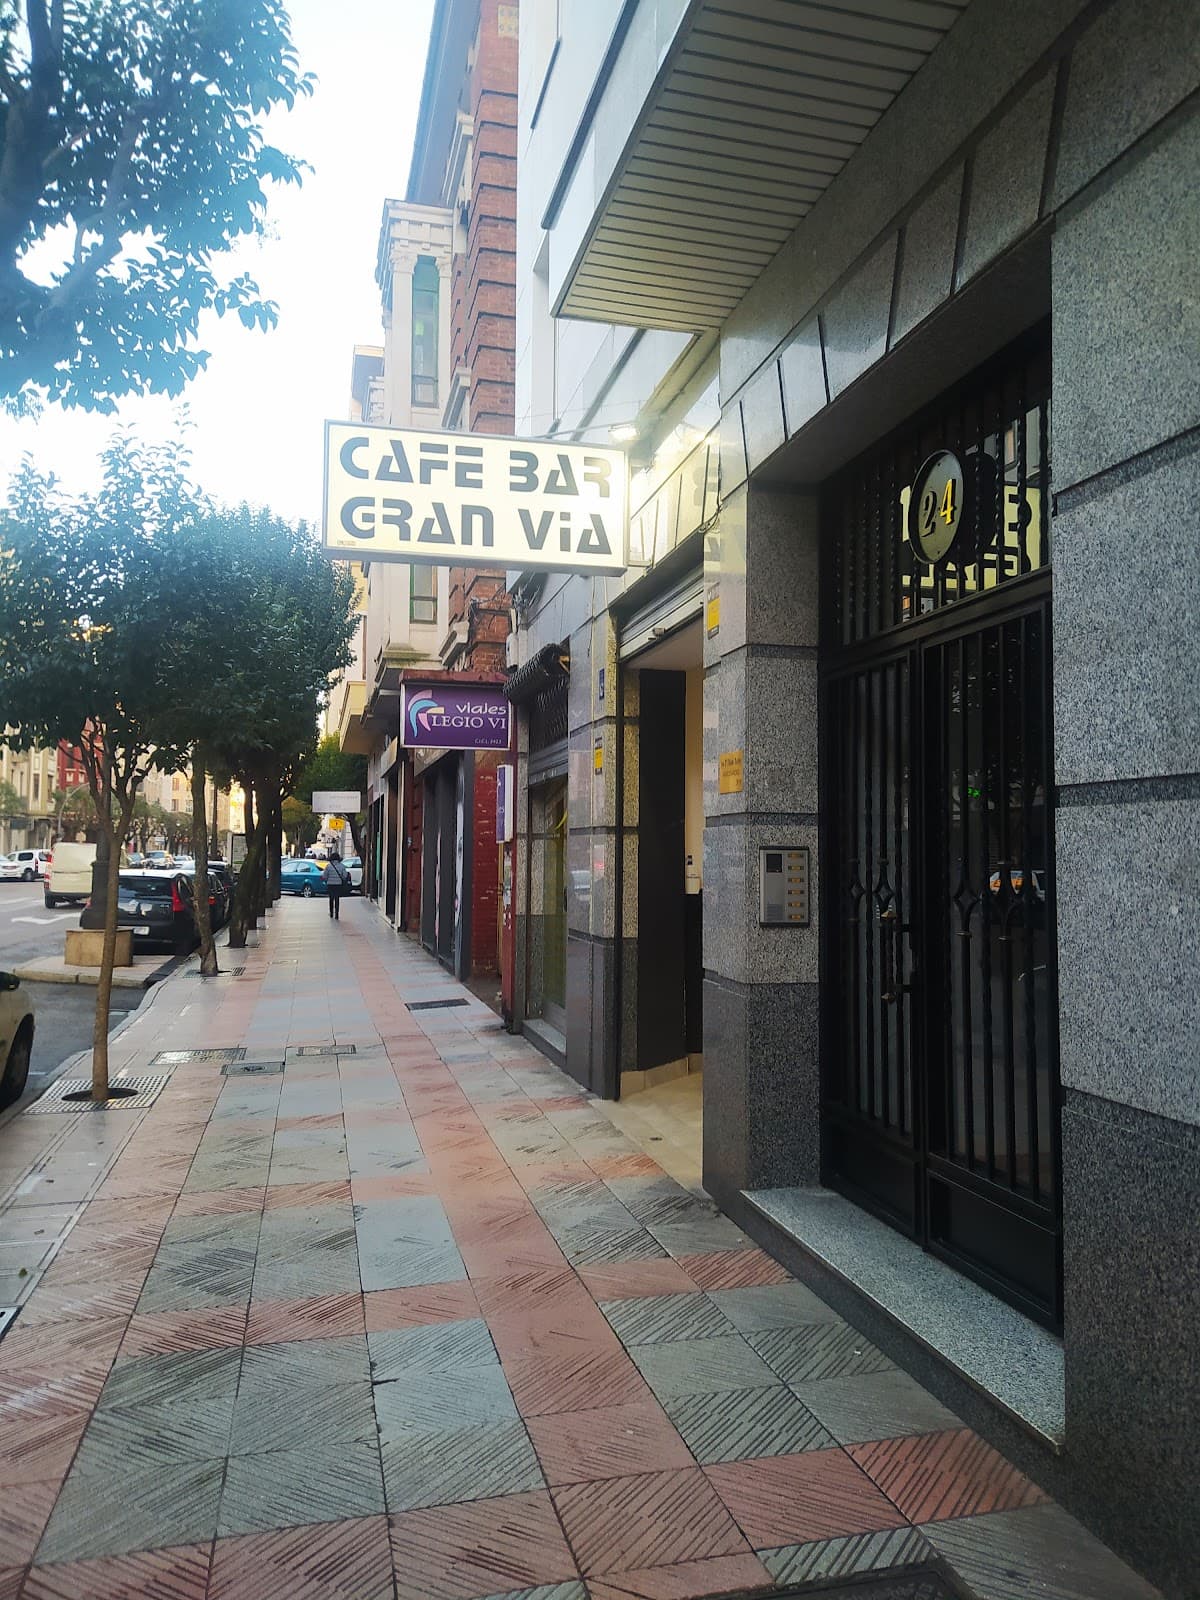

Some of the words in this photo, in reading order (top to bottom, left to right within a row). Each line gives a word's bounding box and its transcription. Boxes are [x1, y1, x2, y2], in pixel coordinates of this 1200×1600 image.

[340, 436, 483, 489] CAFE
[509, 450, 612, 498] BAR
[340, 496, 494, 547] GRAN
[921, 478, 957, 538] 24
[431, 715, 484, 729] LEGIO
[488, 718, 506, 729] VI
[456, 702, 507, 715] viajes
